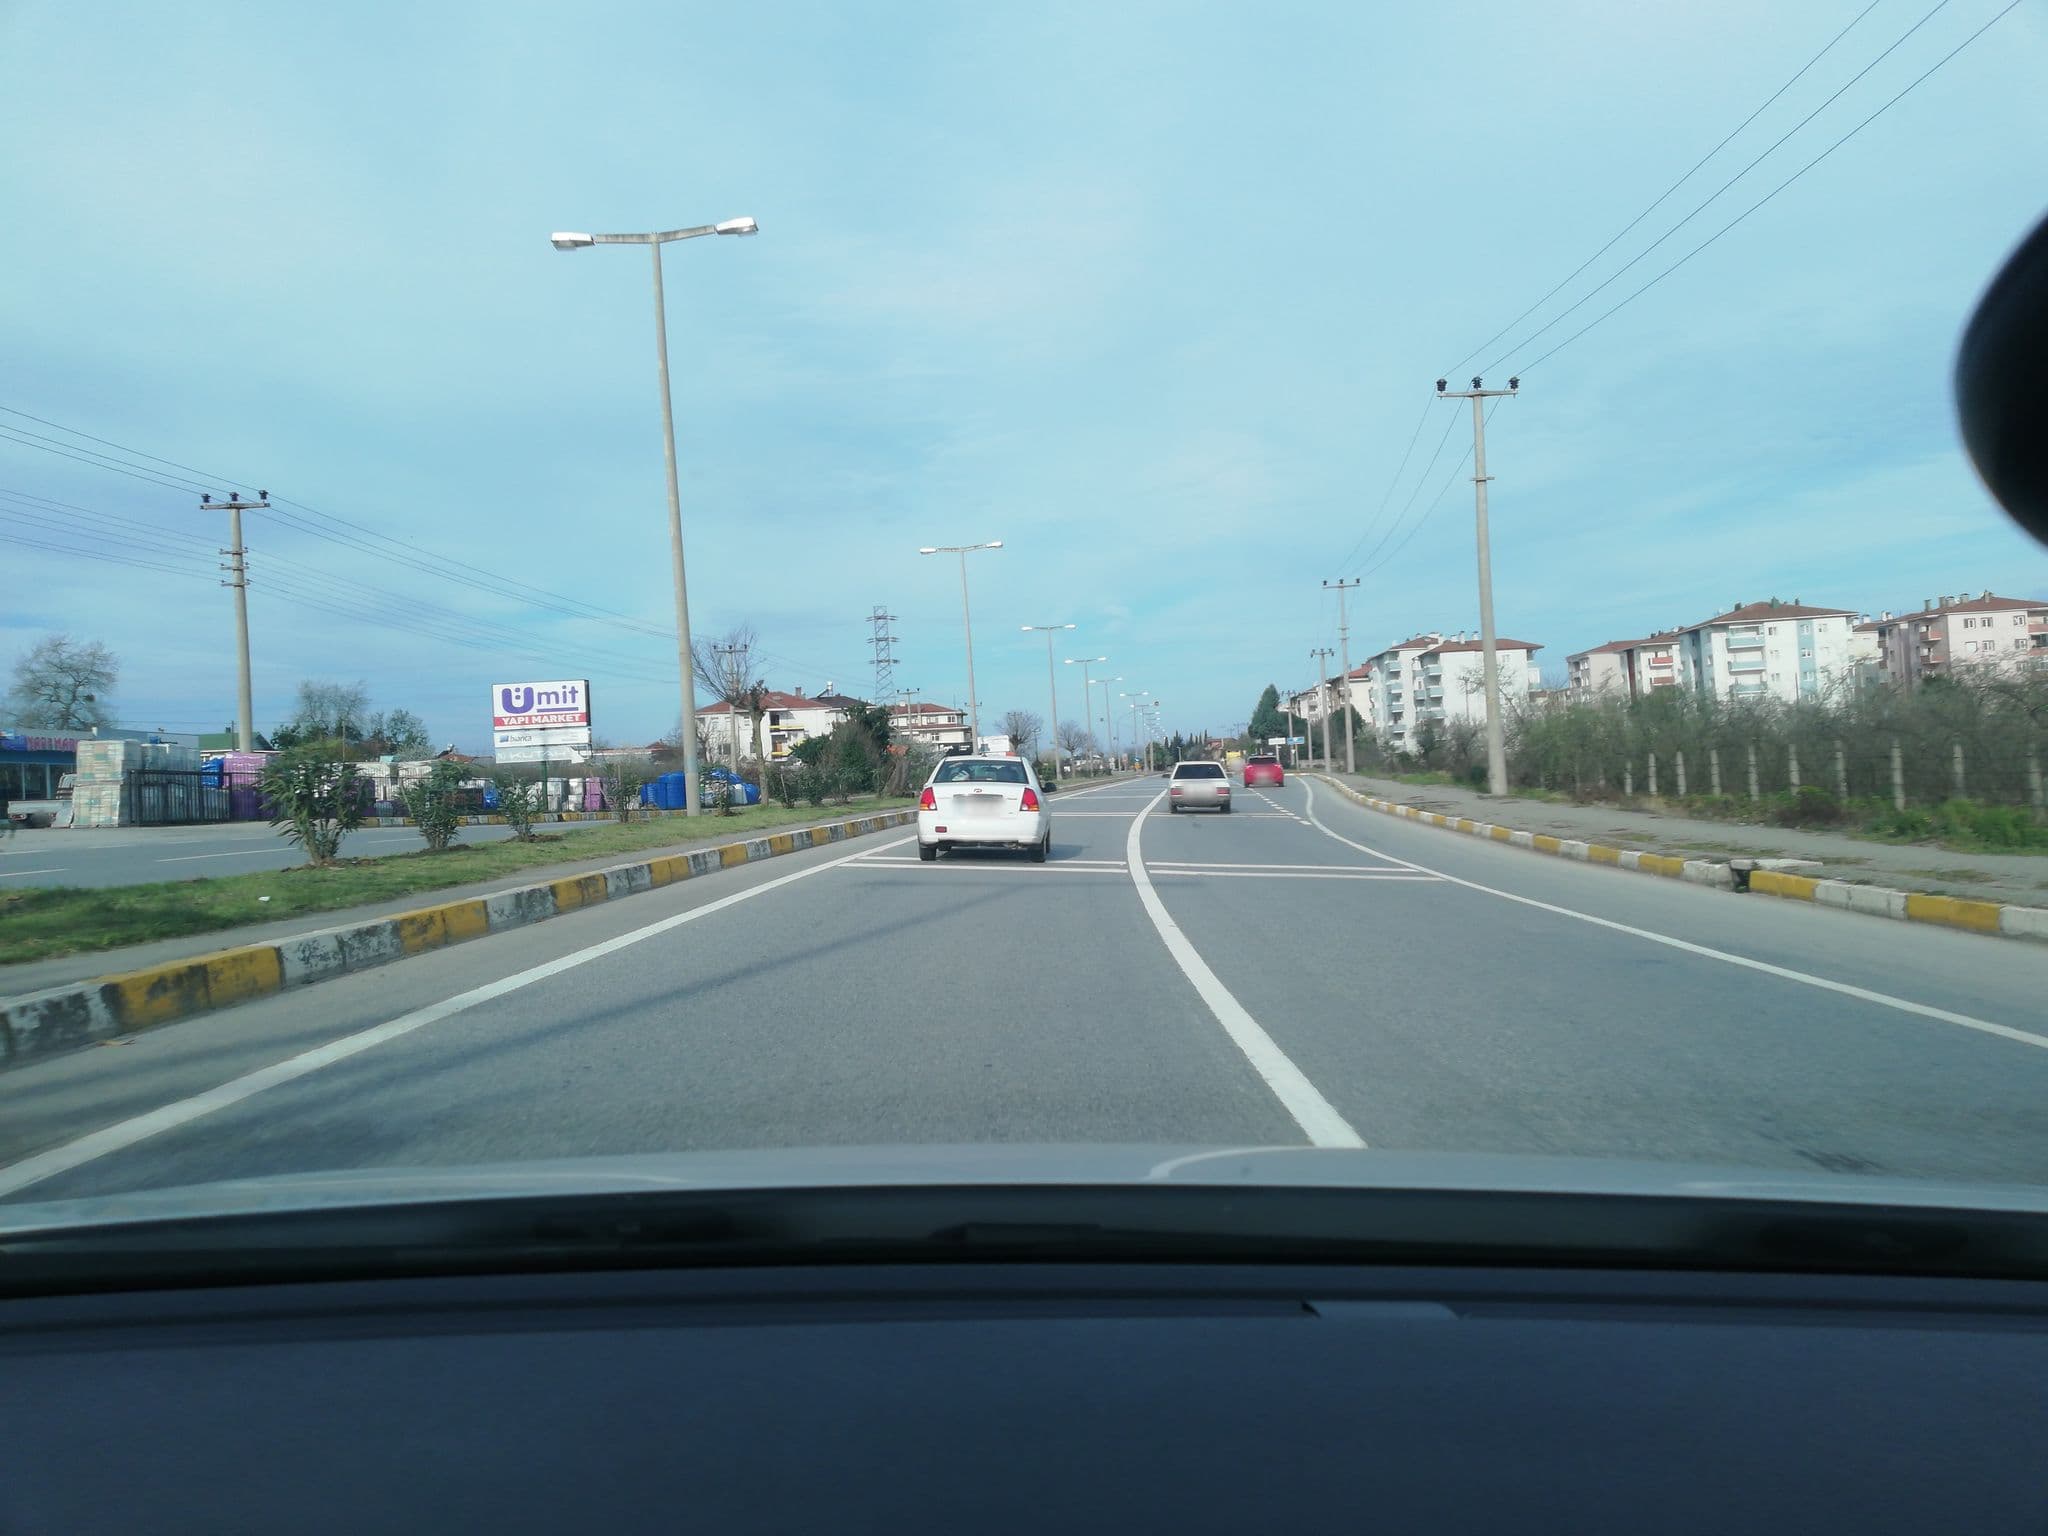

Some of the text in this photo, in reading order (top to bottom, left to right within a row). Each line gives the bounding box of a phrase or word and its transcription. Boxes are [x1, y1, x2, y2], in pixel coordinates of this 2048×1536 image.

[501, 685, 579, 714] Ümit
[502, 714, 581, 725] YAPI MARKET
